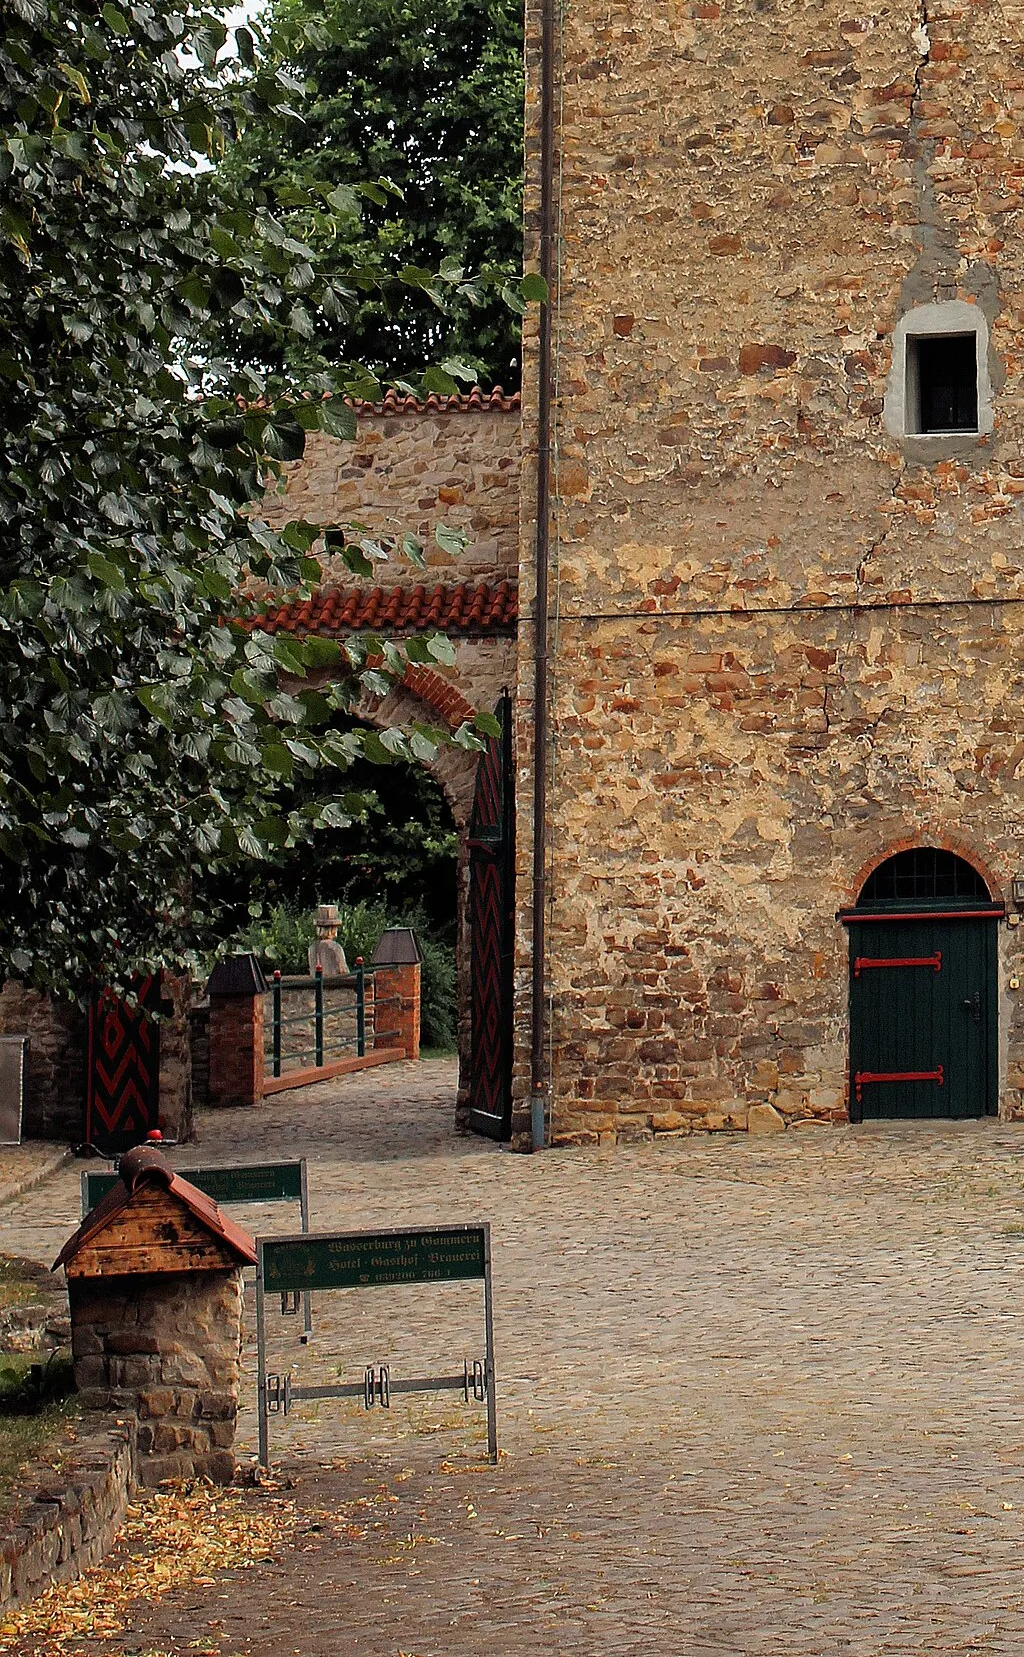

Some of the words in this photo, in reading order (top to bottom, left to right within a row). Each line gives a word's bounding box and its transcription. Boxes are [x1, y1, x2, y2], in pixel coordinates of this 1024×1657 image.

[328, 1239, 401, 1253] Wasserburg
[404, 1238, 418, 1250] zu
[421, 1234, 480, 1247] Gommern
[328, 1257, 361, 1271] Hotel
[370, 1253, 419, 1267] Gasthof
[427, 1249, 480, 1263] Brauerei
